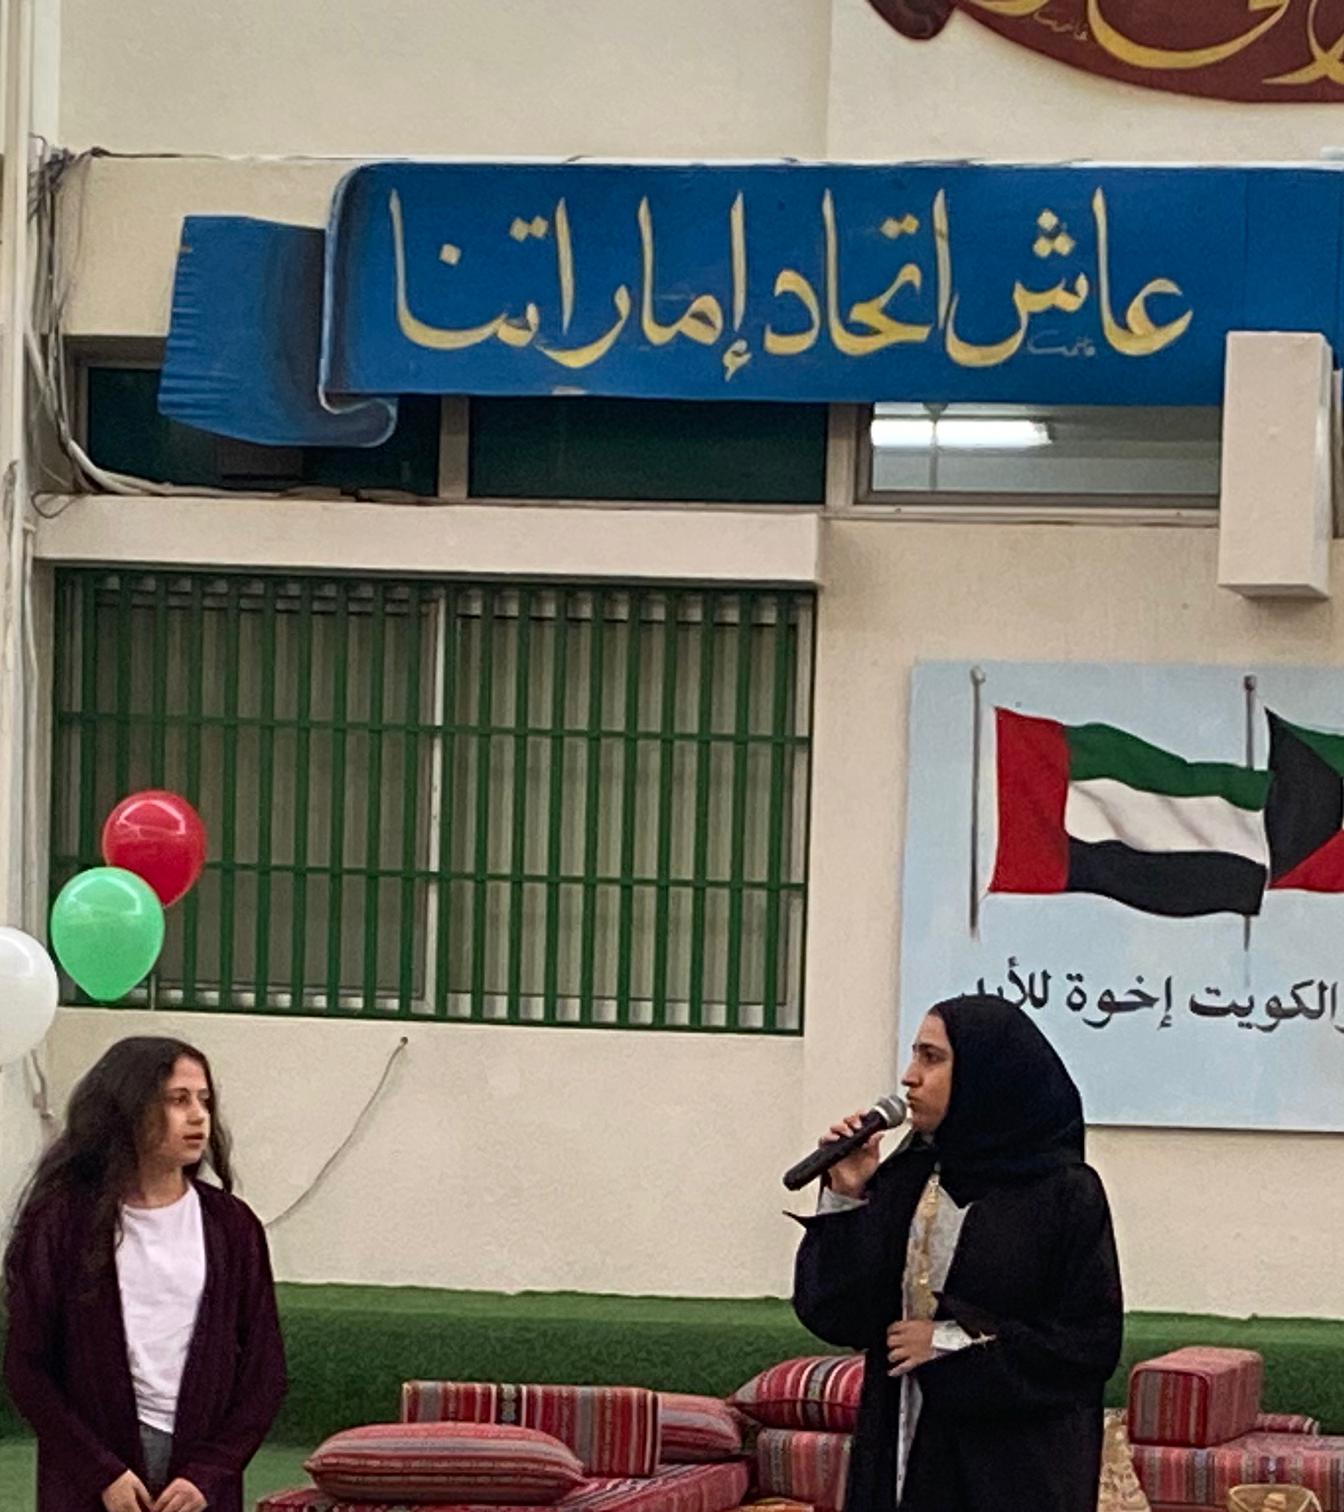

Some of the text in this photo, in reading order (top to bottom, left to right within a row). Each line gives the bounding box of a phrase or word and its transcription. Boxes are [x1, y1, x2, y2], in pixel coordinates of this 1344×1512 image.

[388, 187, 750, 380] إماراتنا
[762, 187, 952, 358] اتحاد
[944, 188, 1194, 369] عاش
[1064, 973, 1174, 1031] إخوة
